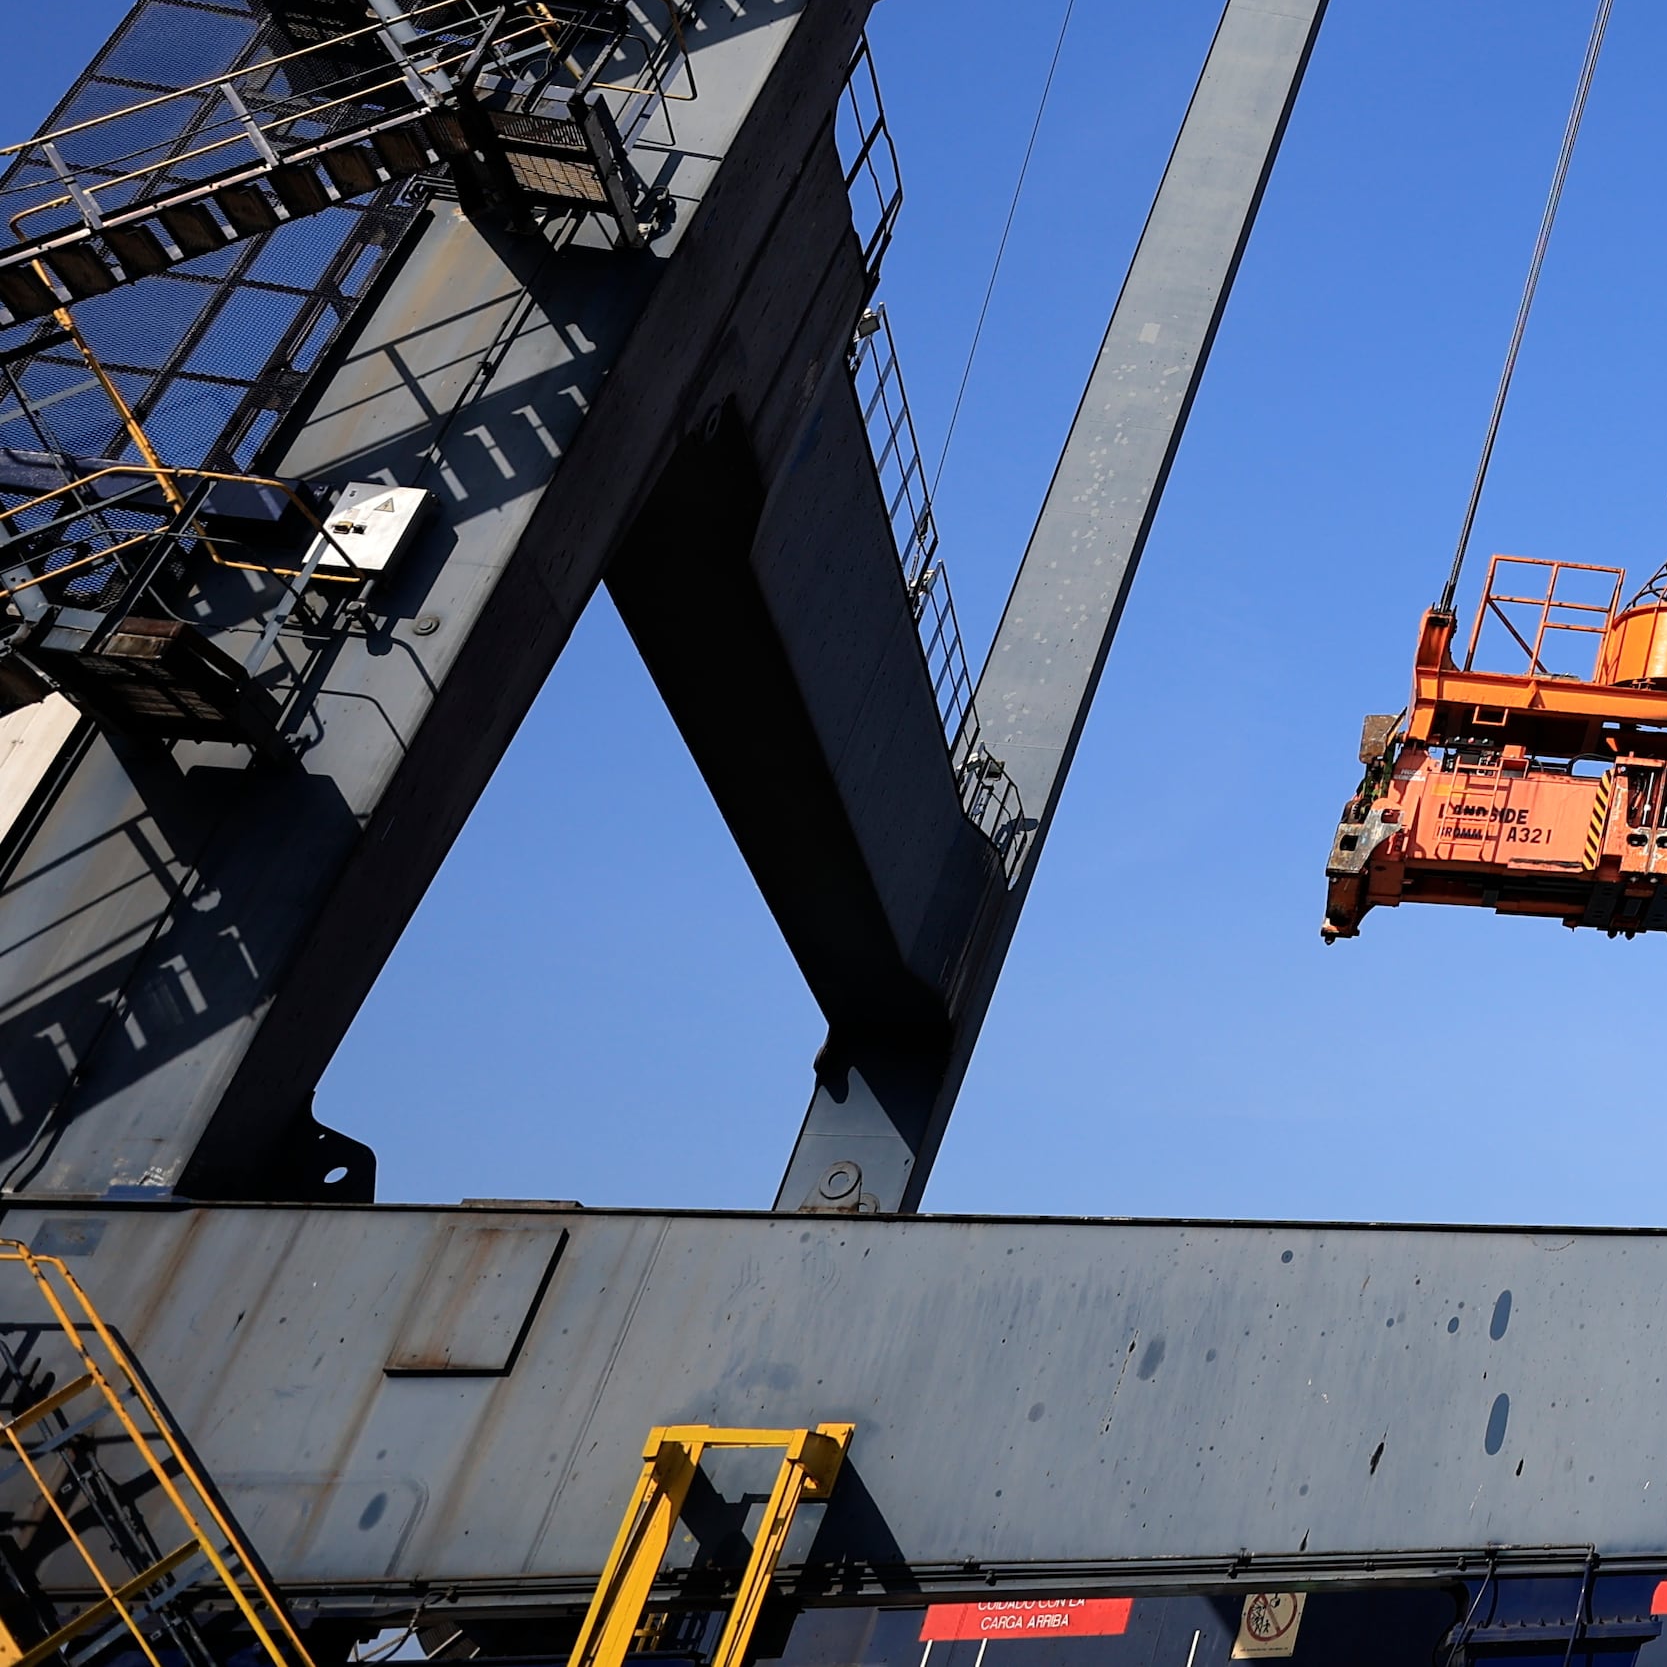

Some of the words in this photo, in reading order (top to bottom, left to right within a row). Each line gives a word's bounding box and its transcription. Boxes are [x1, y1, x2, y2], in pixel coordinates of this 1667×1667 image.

[1505, 827, 1553, 845] A321
[977, 1598, 1037, 1611] CUIDADO
[980, 1614, 1023, 1631] CARGA
[1026, 1613, 1070, 1629] ARRIBA
